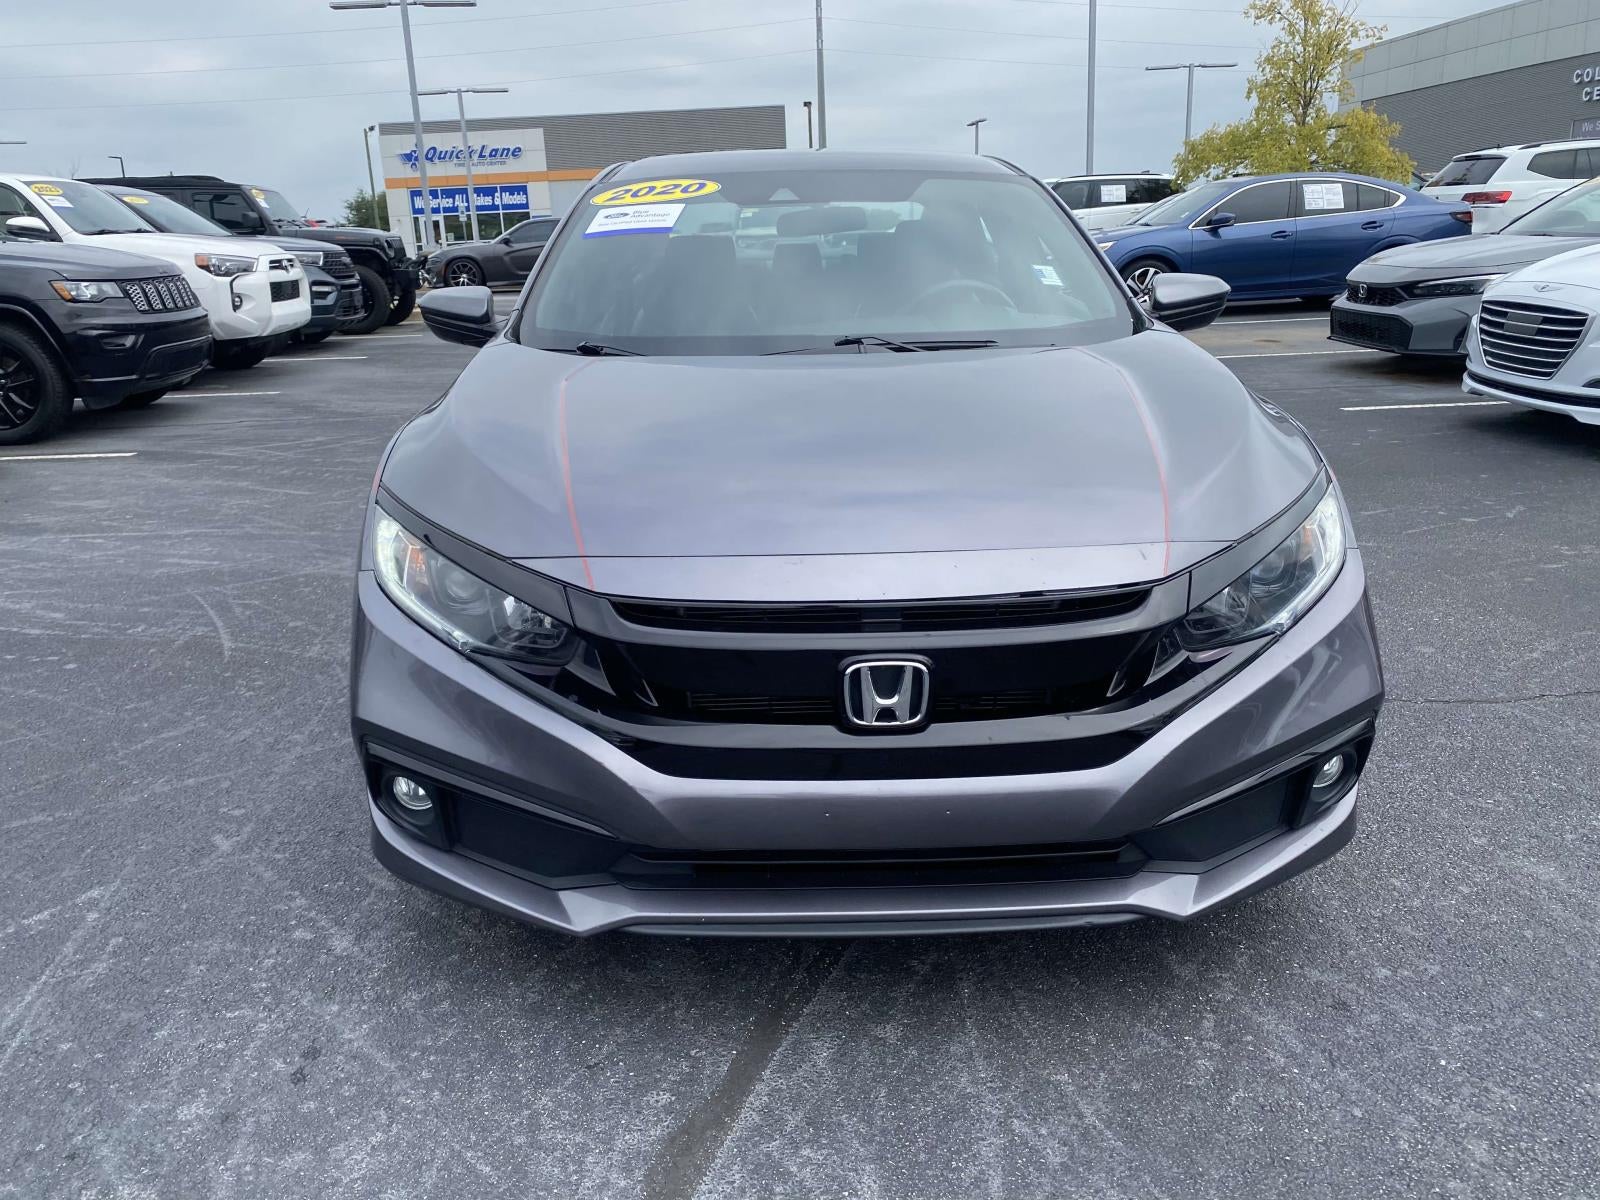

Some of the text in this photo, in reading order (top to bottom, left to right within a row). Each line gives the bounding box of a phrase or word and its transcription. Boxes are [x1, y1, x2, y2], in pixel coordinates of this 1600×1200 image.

[478, 144, 521, 159] Lane
[455, 194, 468, 206] ALL
[474, 193, 492, 205] akes
[502, 192, 528, 204] Models
[602, 183, 707, 202] 2020
